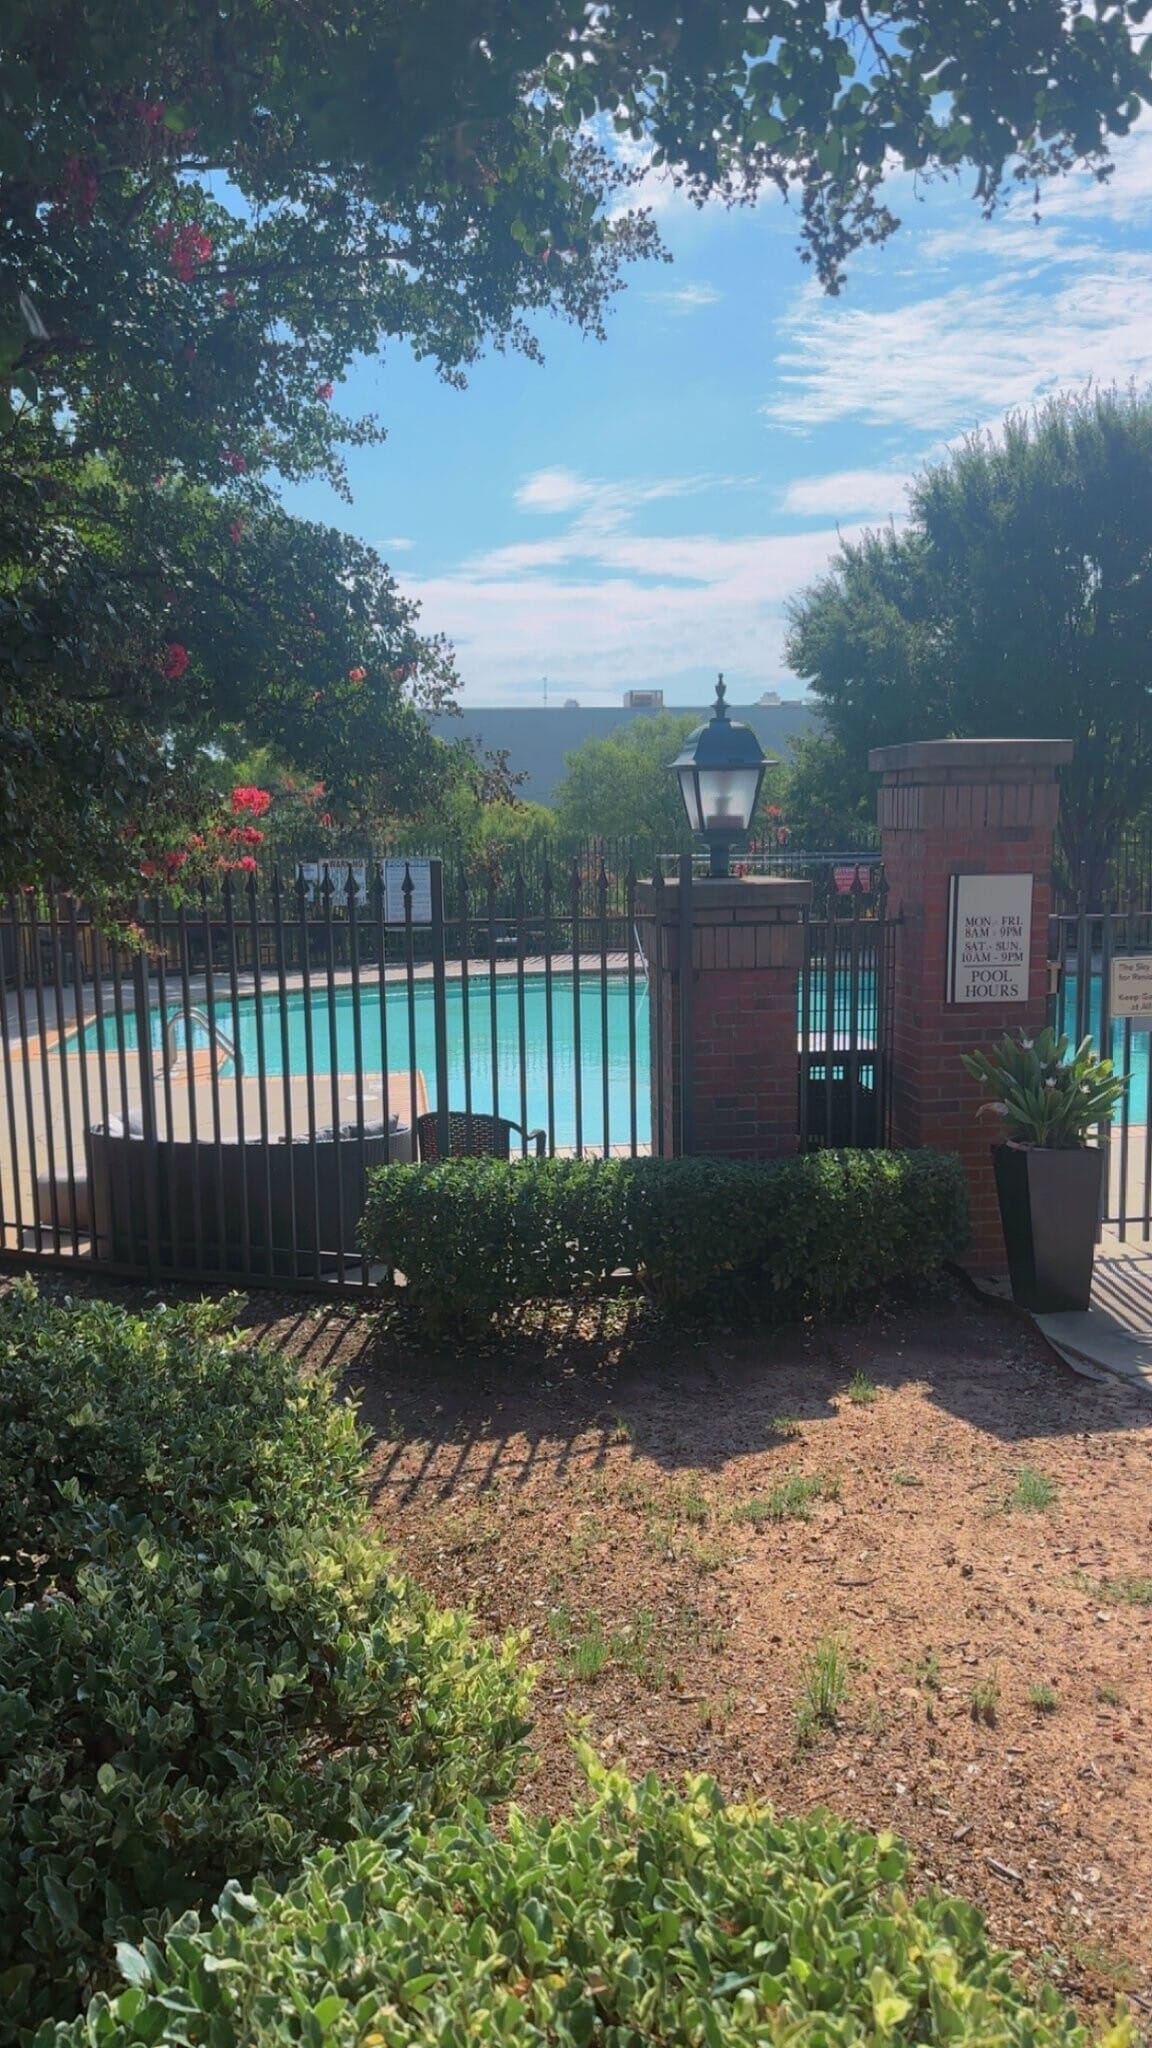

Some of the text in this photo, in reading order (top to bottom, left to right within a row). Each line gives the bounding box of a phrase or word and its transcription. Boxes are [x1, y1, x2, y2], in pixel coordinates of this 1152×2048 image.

[965, 927, 990, 938] 8AM
[1000, 926, 1022, 937] 9PM
[962, 952, 990, 962] 10AM
[1001, 952, 1024, 962] 9PM
[971, 969, 1013, 982] POOL
[966, 984, 1019, 997] HOURS
